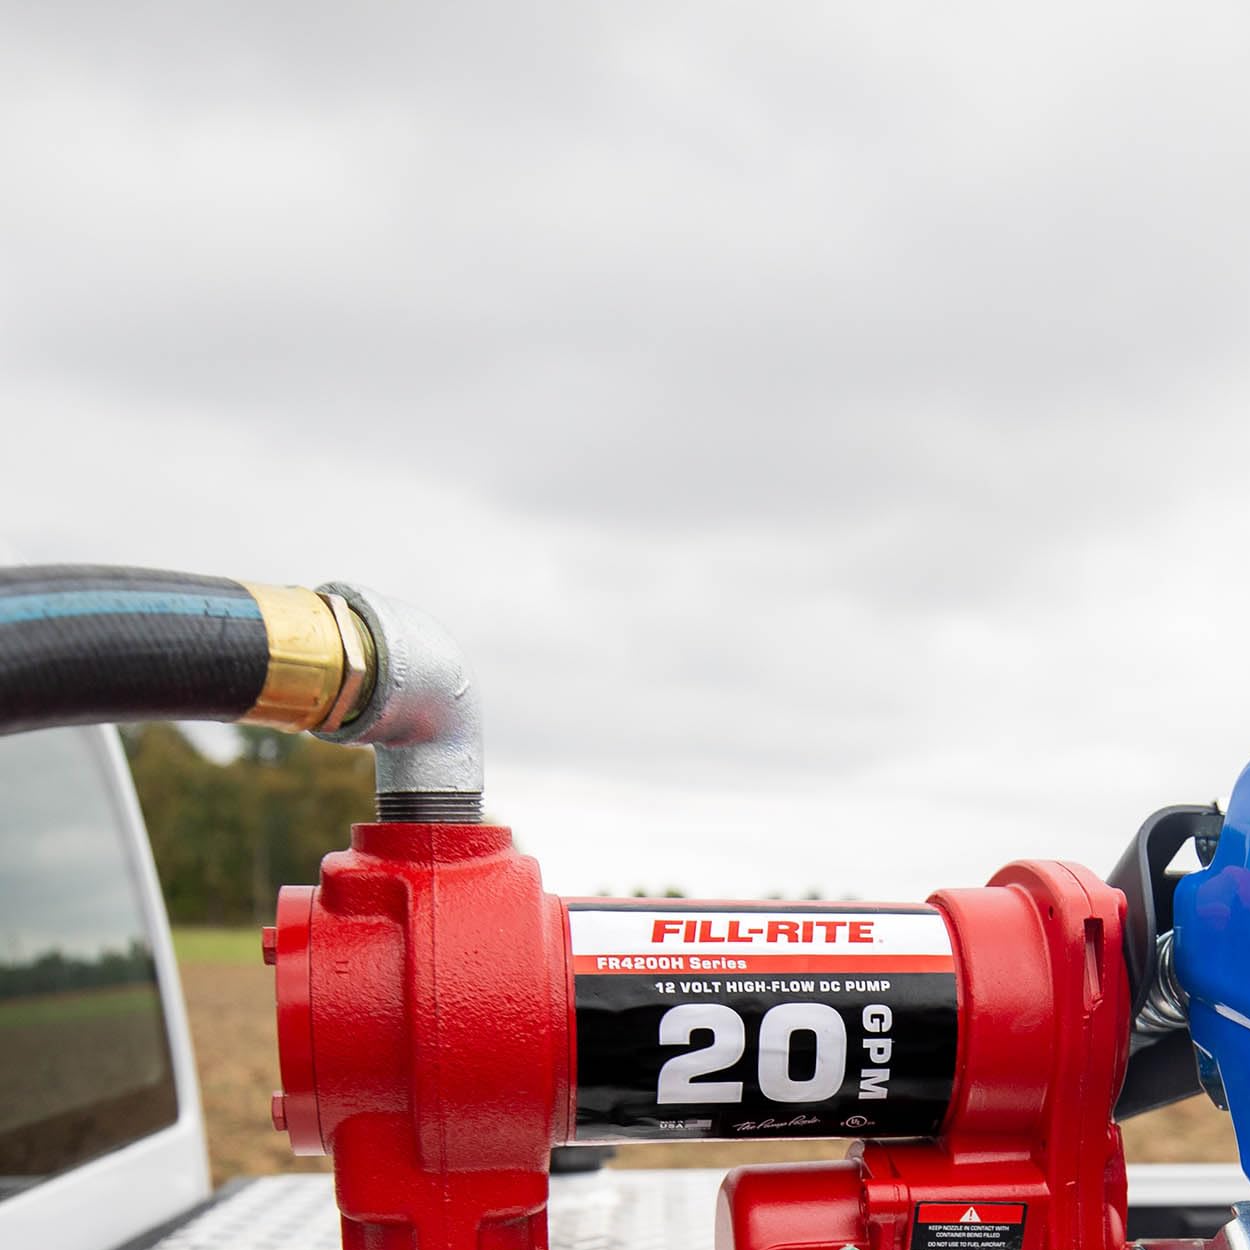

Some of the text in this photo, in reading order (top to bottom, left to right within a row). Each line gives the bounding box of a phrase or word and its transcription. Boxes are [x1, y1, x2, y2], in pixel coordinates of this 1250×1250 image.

[651, 919, 874, 943] FILL-RITE
[596, 956, 747, 970] FR4200H Series
[655, 980, 891, 994] 12 VOLT HIGH-FLOW DC PUMP
[657, 1002, 848, 1104] 20
[858, 1004, 893, 1100] GPM
